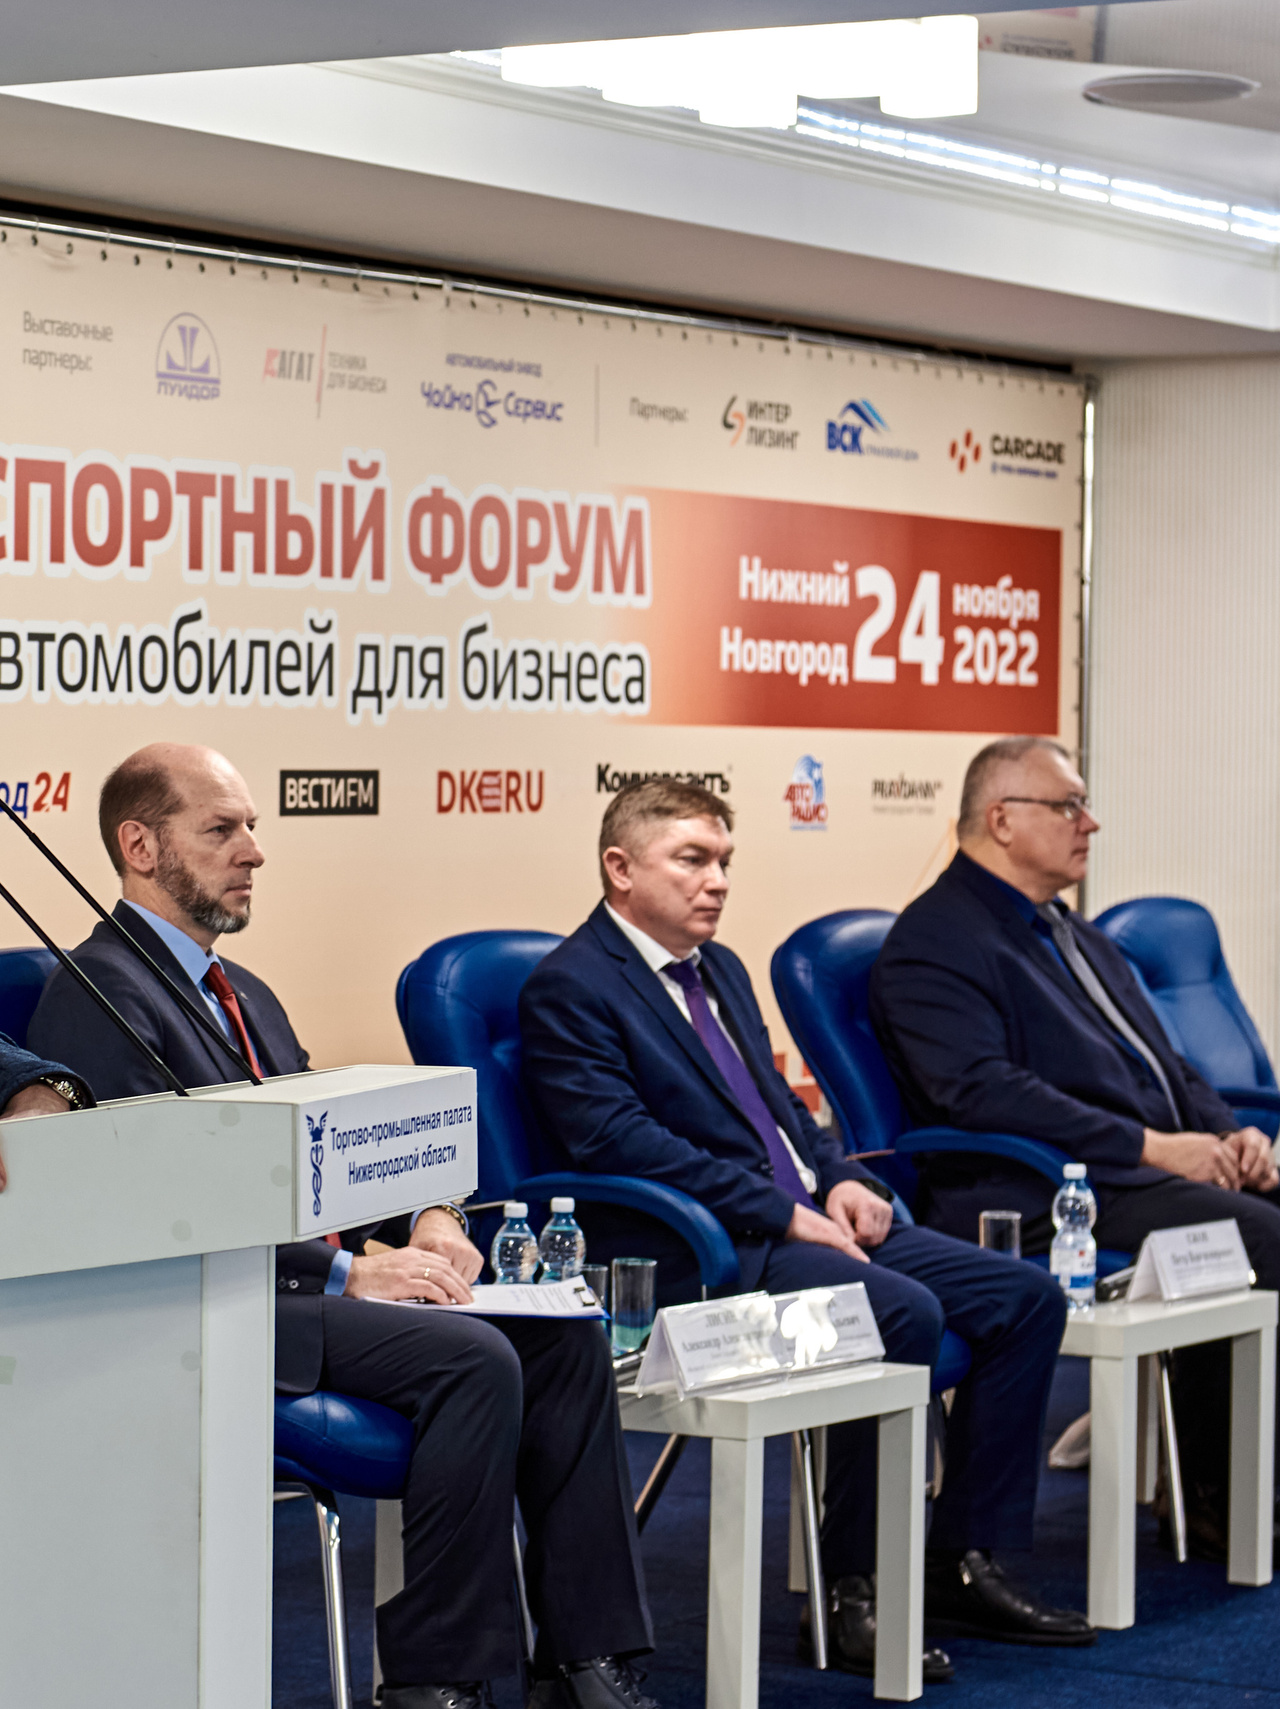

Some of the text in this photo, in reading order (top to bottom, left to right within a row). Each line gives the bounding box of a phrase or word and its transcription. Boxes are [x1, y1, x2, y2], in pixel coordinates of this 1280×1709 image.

[23, 311, 113, 342] Выставочные
[23, 348, 93, 375] партнеры:
[503, 390, 564, 424] Сервис
[747, 400, 792, 424] ИНТЕР
[826, 420, 864, 455] ВСК
[991, 433, 1065, 465] CARCADE
[408, 486, 645, 596] ФОРУМ
[738, 554, 850, 608] Нижний
[951, 573, 1041, 630] ноября
[853, 563, 946, 687] 24
[351, 643, 444, 715] для
[462, 622, 645, 705] бизнеса
[719, 624, 850, 687] Новгород
[951, 625, 1040, 688] 2022
[33, 771, 72, 813] 24
[330, 1104, 473, 1155] Торгово-промышленная палата
[348, 1143, 458, 1186] Нижегородской области
